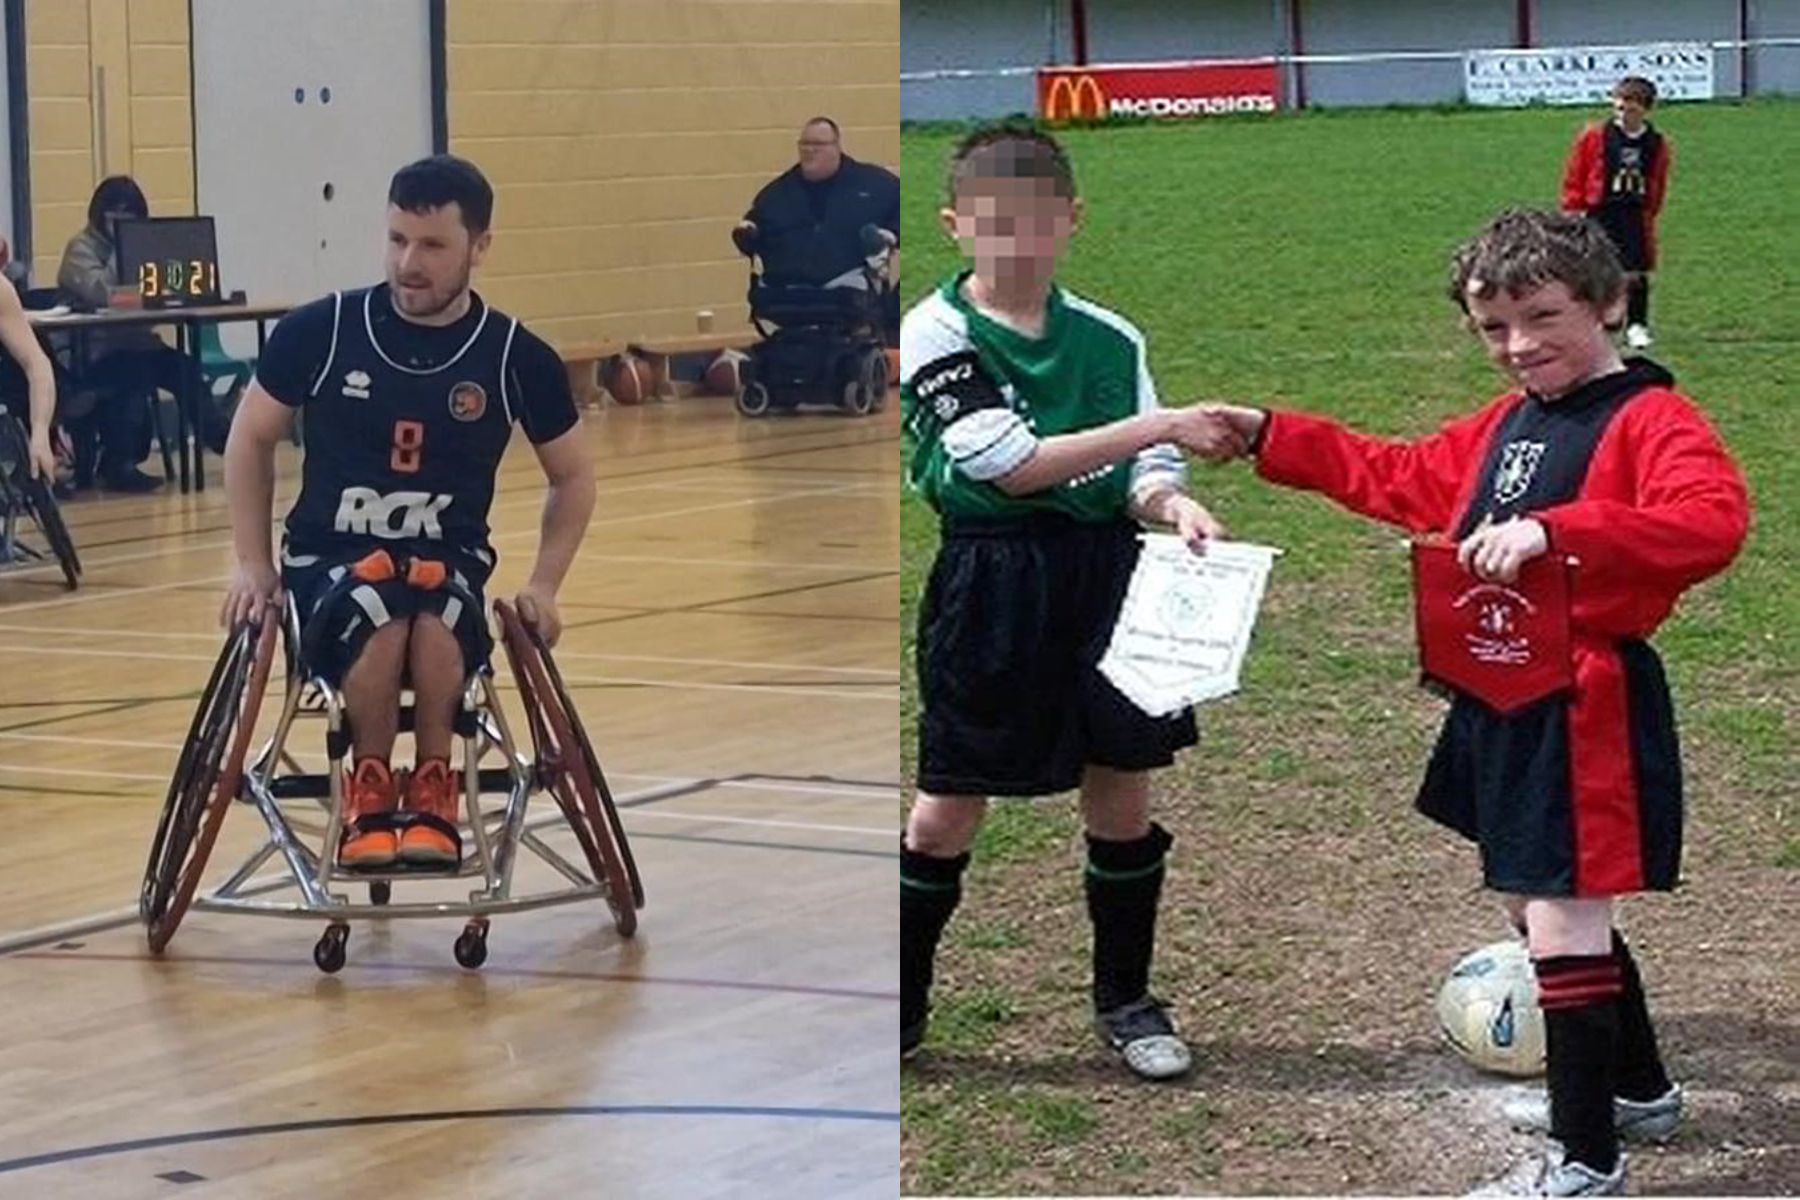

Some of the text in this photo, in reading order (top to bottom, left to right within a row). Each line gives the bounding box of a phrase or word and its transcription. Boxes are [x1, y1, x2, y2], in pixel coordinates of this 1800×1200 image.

[1638, 50, 1709, 70] SONS
[1110, 96, 1276, 116] McDonald's
[139, 262, 158, 296] 13
[190, 261, 215, 295] 21
[391, 420, 424, 472] 8
[334, 487, 453, 540] RCK
